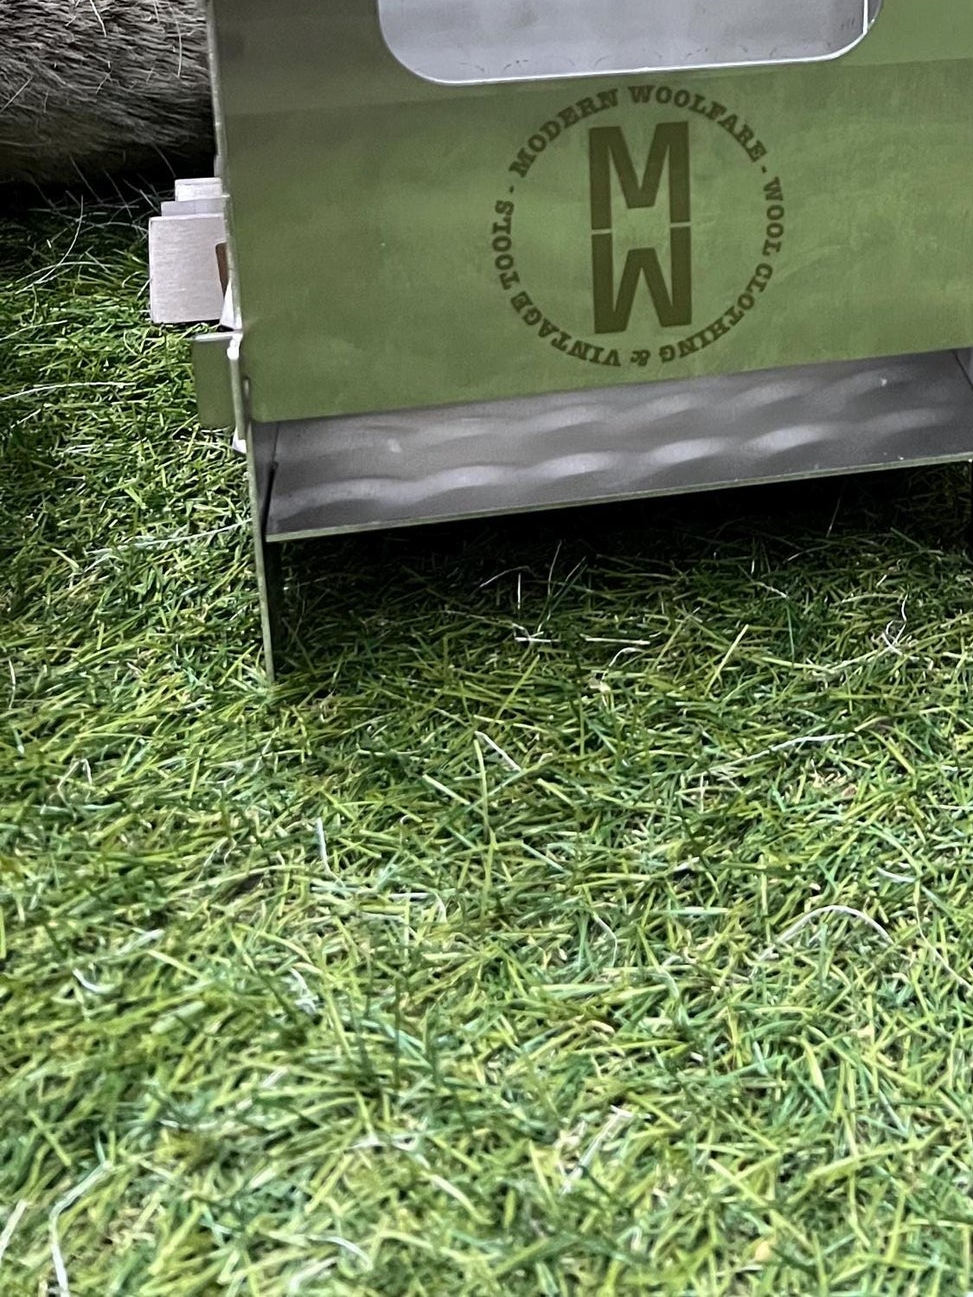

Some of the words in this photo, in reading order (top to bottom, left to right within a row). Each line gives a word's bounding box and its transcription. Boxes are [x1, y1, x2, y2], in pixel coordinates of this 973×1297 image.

[509, 88, 618, 178] MODERN
[628, 84, 767, 162] WOOLFARE
[588, 121, 691, 231] M
[763, 176, 785, 257] WOOL
[491, 199, 520, 290] TOOLS
[510, 291, 622, 367] VINTAGE
[659, 263, 773, 363] CLOTHING
[630, 350, 651, 367] &
